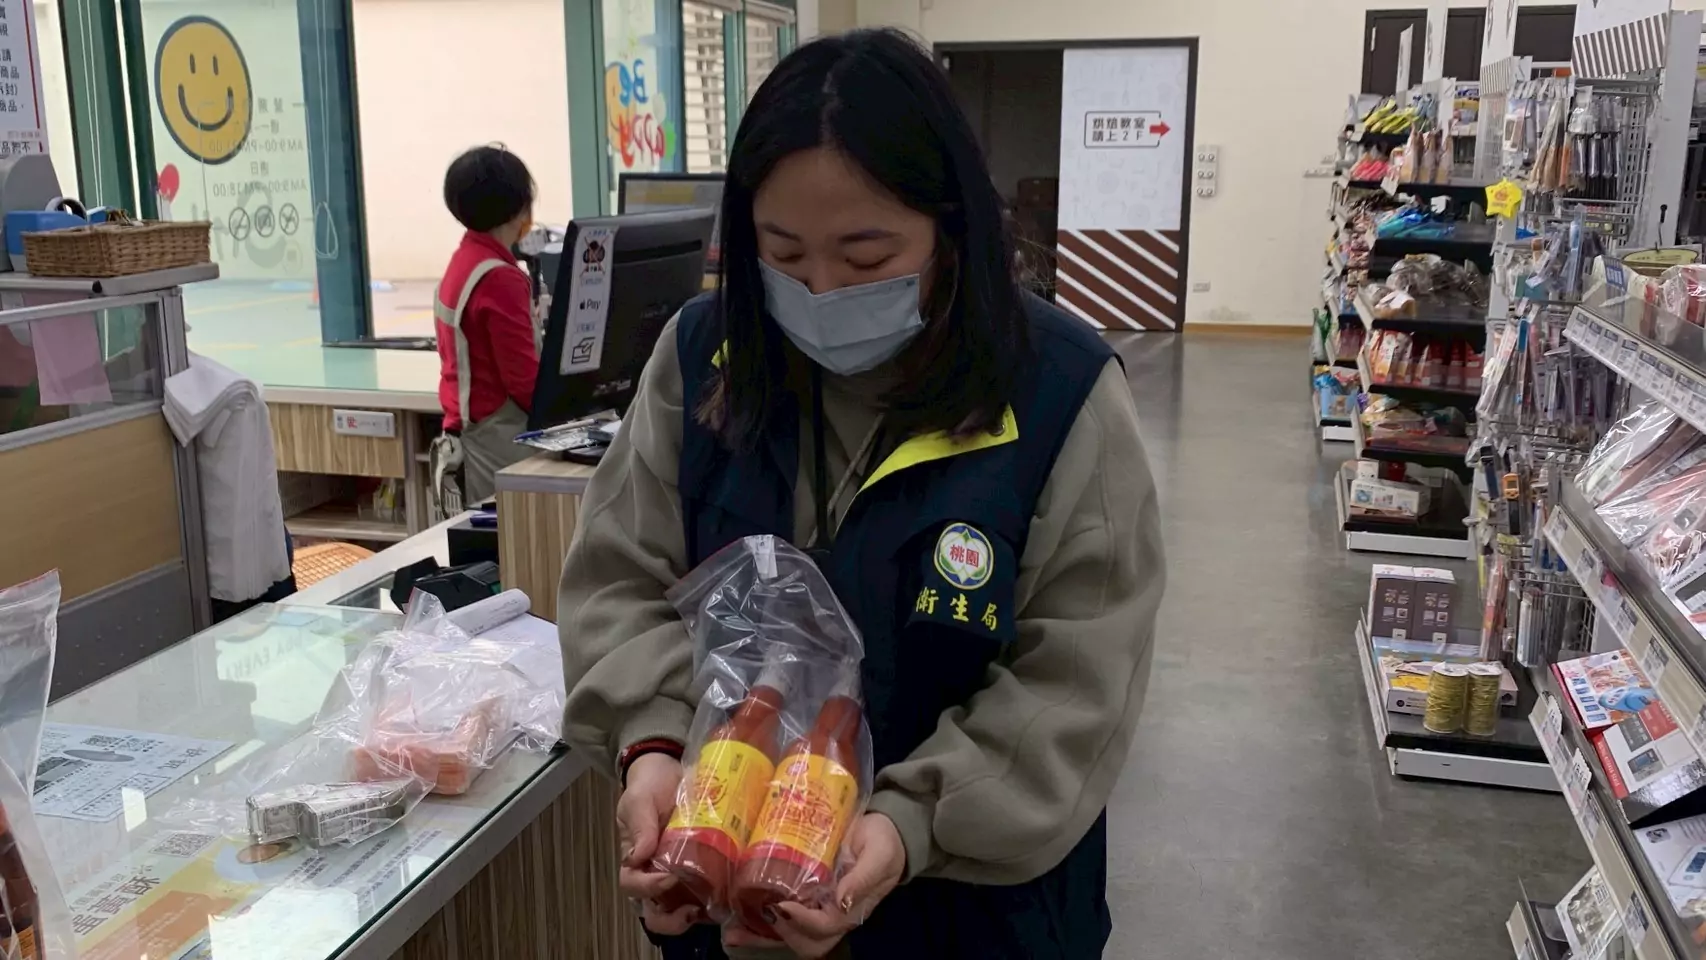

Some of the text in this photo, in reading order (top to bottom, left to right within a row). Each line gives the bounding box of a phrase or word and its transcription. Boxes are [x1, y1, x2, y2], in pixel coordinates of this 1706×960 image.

[1092, 116, 1146, 129] 烘焙教室
[587, 299, 601, 311] Pay
[949, 544, 980, 568] 桃園
[915, 586, 998, 631] 衛生局
